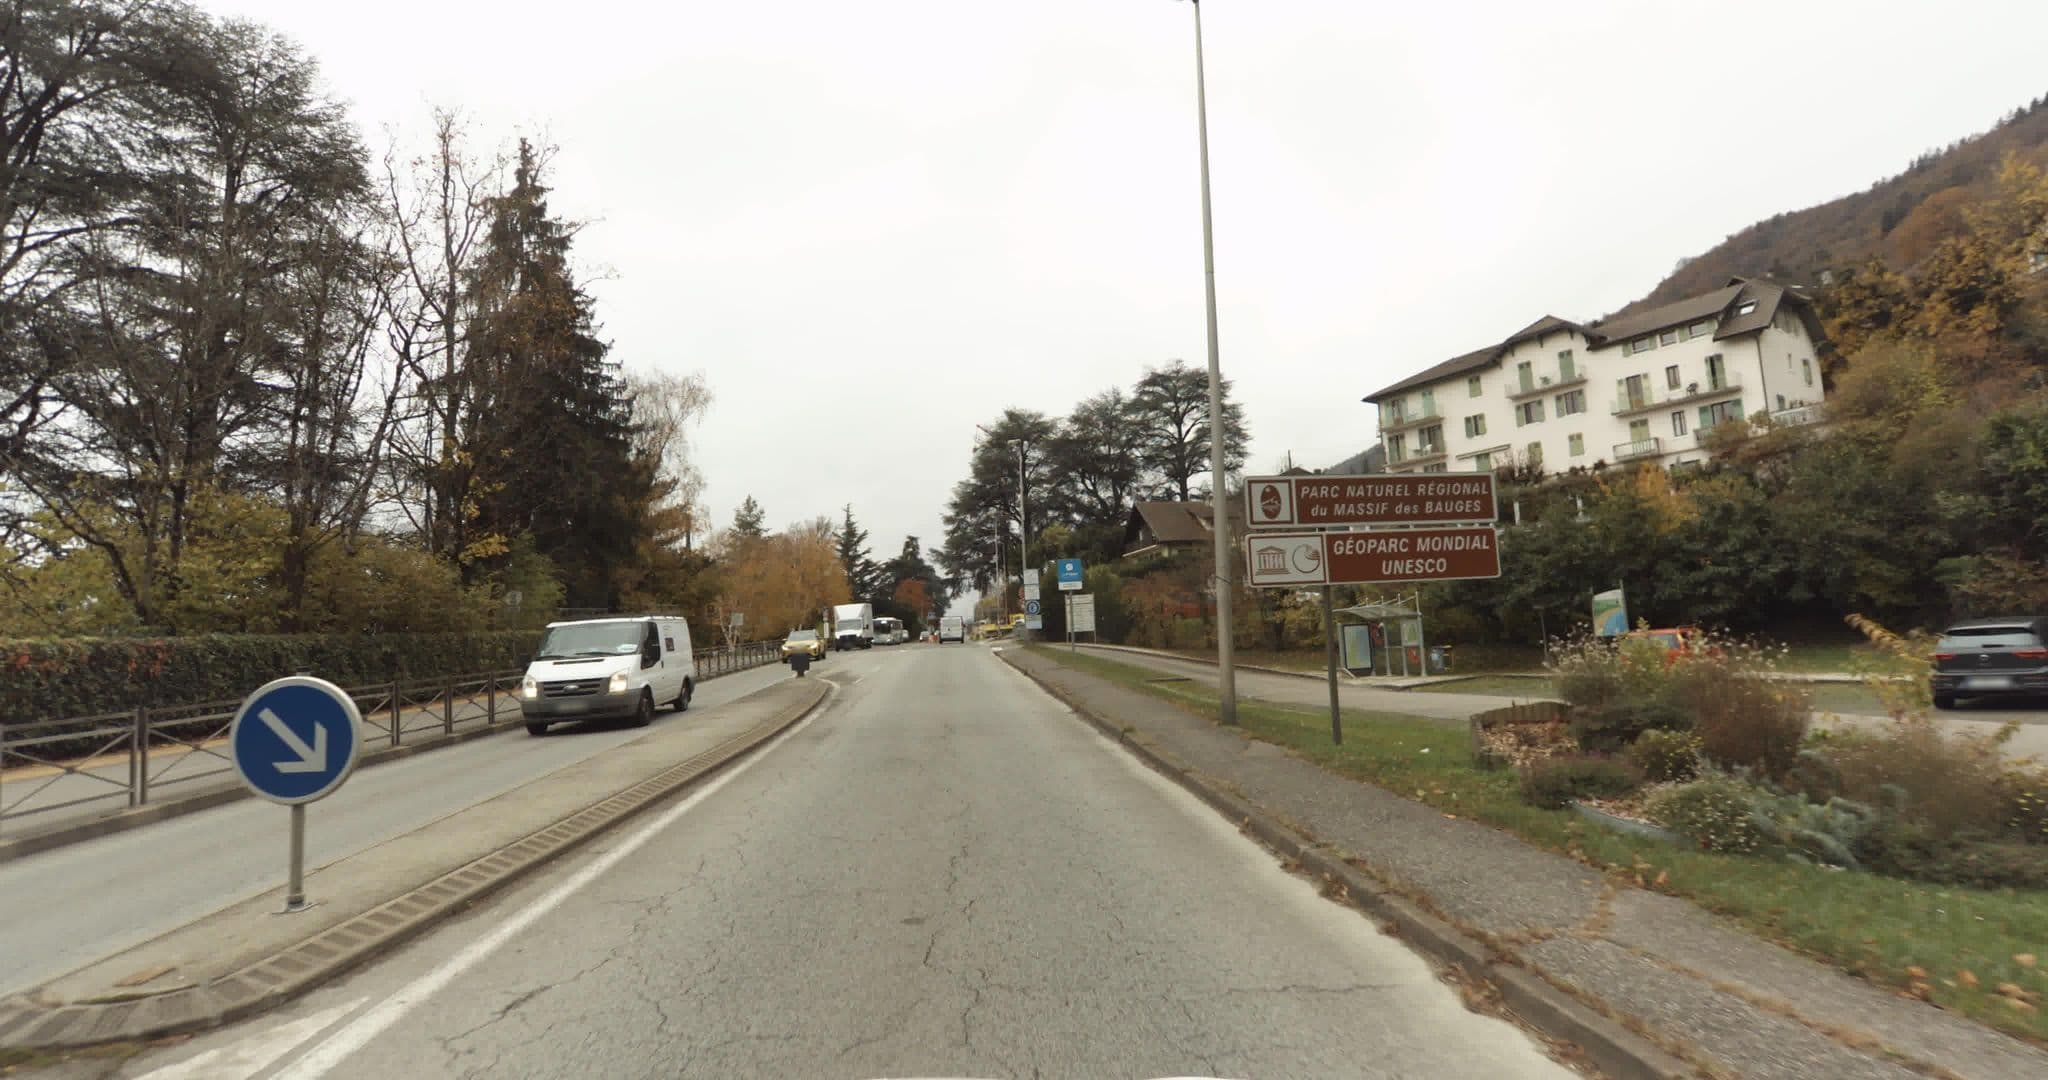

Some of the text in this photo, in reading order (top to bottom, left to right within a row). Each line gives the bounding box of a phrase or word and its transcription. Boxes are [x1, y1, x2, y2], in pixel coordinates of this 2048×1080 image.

[1300, 480, 1489, 499] PARC NATUREL RÉGIONAL
[1311, 499, 1481, 517] du MASSIF des BAUGES
[1333, 534, 1490, 556] GÉOPARC MONDIAL
[1382, 558, 1447, 575] UNESCO
